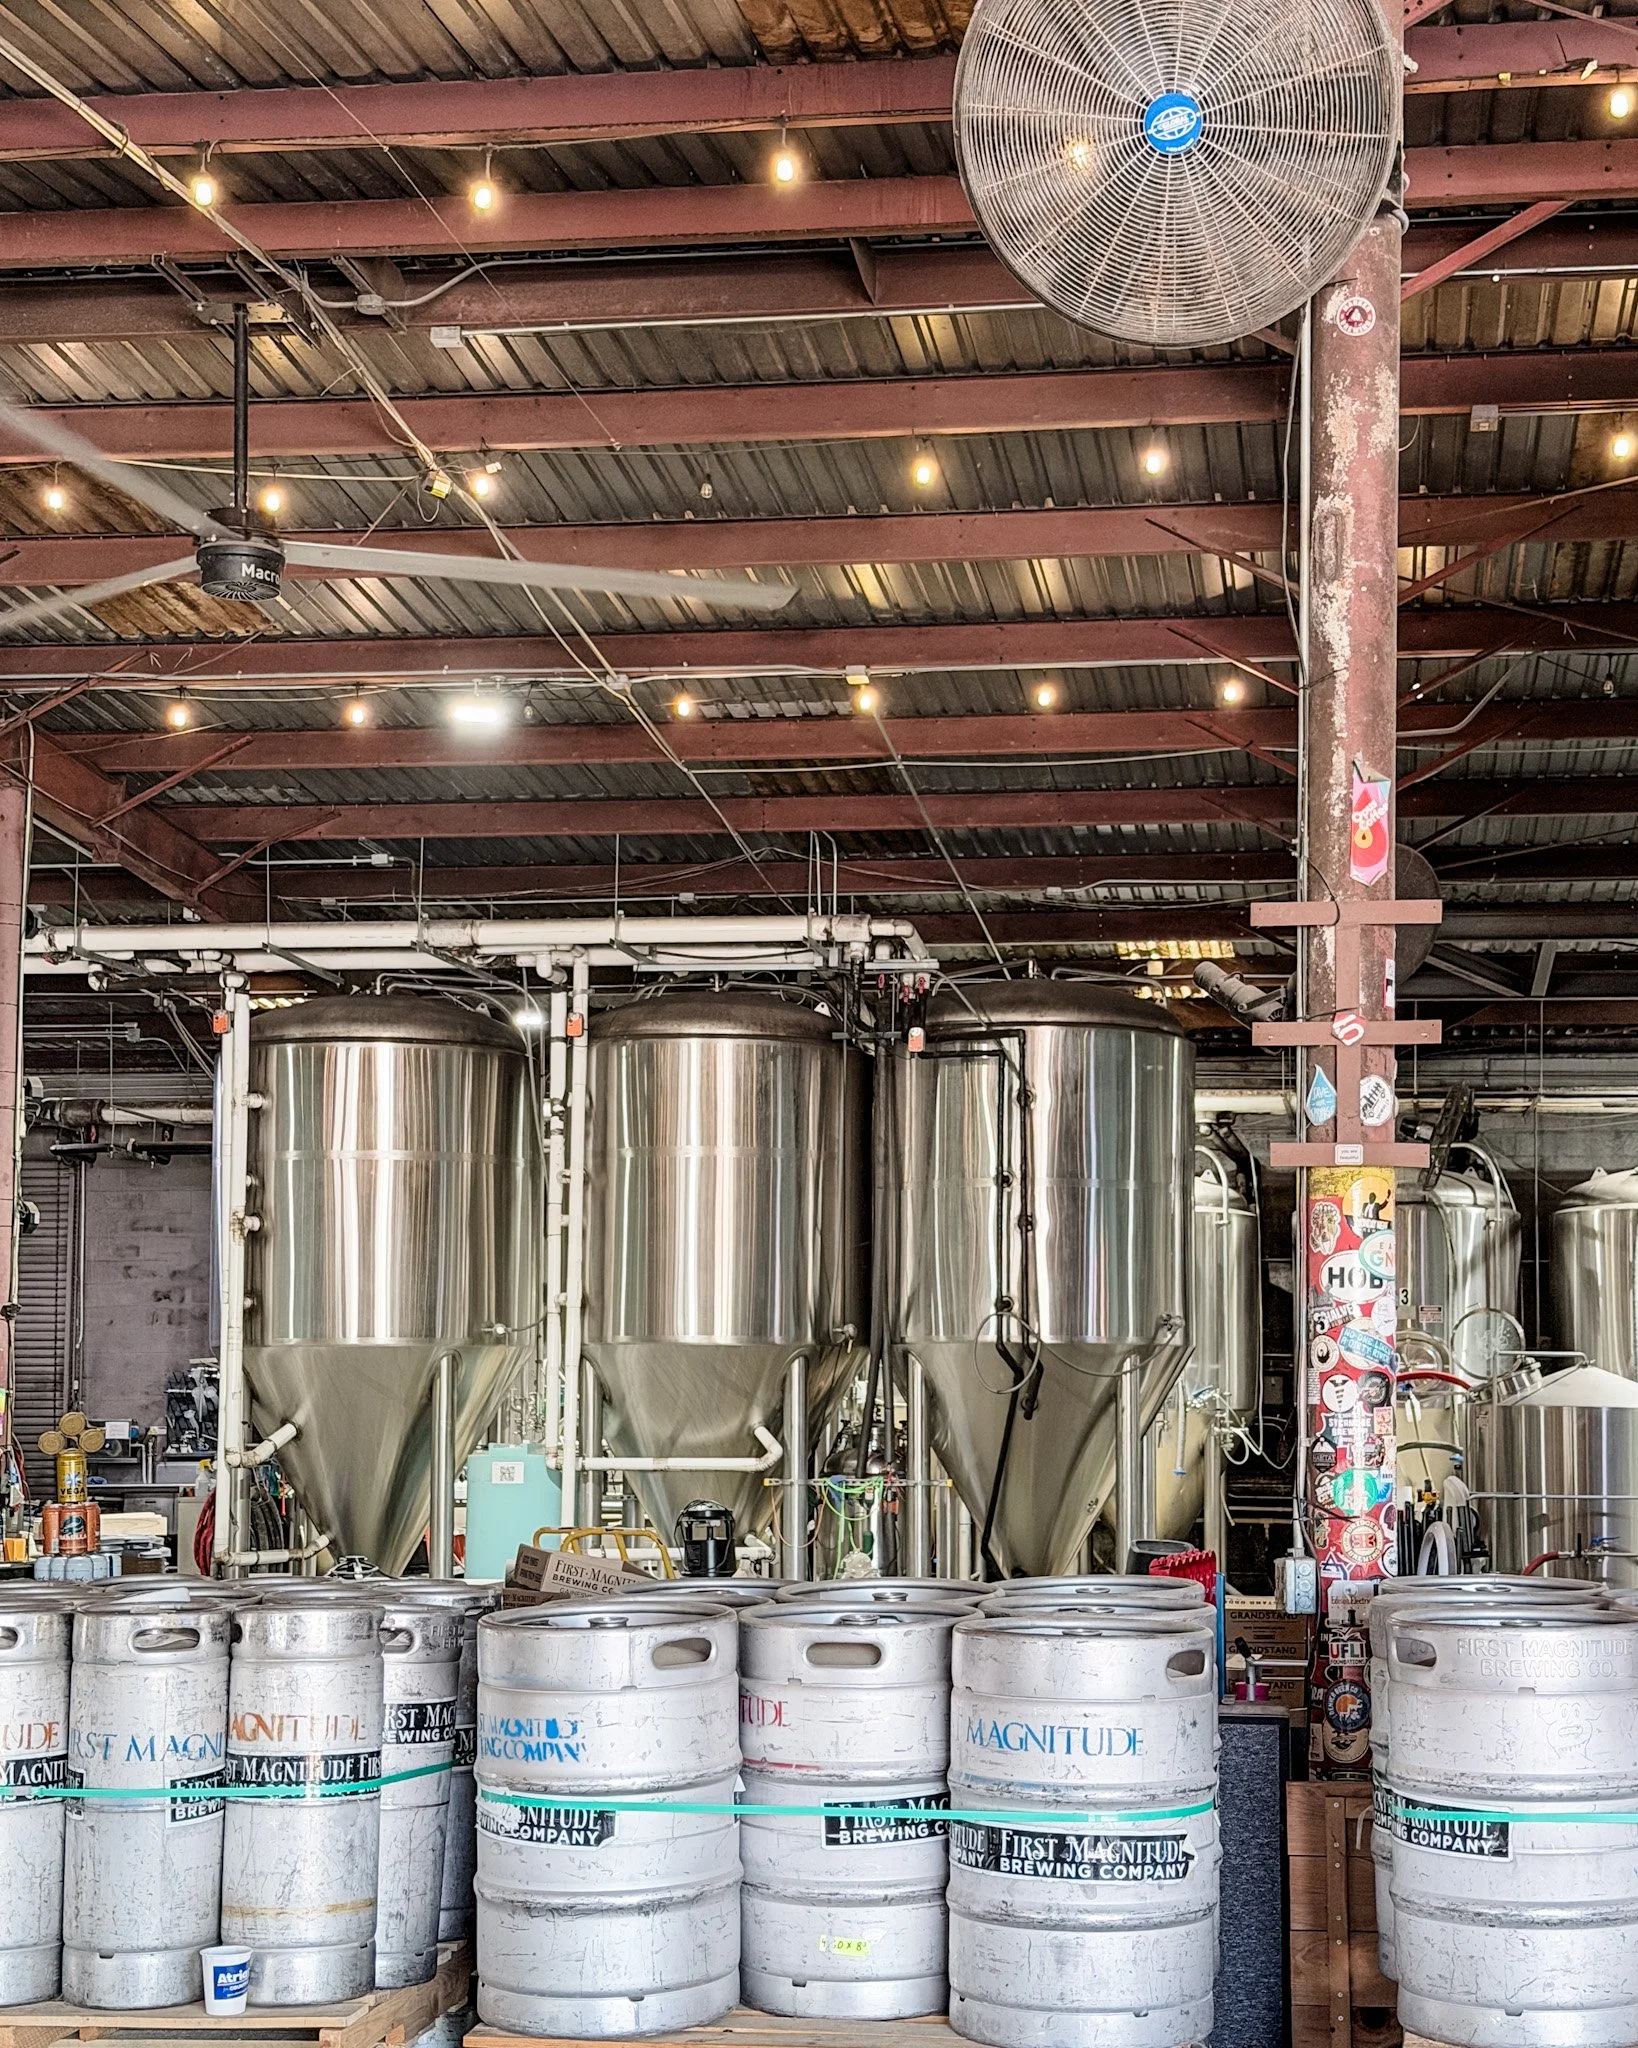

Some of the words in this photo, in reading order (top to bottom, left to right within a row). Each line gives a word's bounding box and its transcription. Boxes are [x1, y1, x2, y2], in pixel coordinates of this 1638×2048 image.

[1401, 1289, 1409, 1305] 3
[553, 1574, 598, 1591] BREWING
[1228, 1646, 1297, 1654] GNDSTAND
[1331, 1643, 1364, 1658] UFLI
[1456, 1638, 1511, 1657] FIRST
[1521, 1638, 1633, 1657] MAGNITUDE
[1481, 1659, 1580, 1678] BREWING
[966, 1716, 1145, 1757] MAGNITUDE
[241, 1756, 355, 1783] MAGNITUDE
[839, 1823, 929, 1845] BREWING
[1410, 1829, 1493, 1855] COMPANY
[1000, 1829, 1059, 1861] FIRST
[1000, 1859, 1092, 1878] BREWING
[1100, 1864, 1187, 1881] COMPANY
